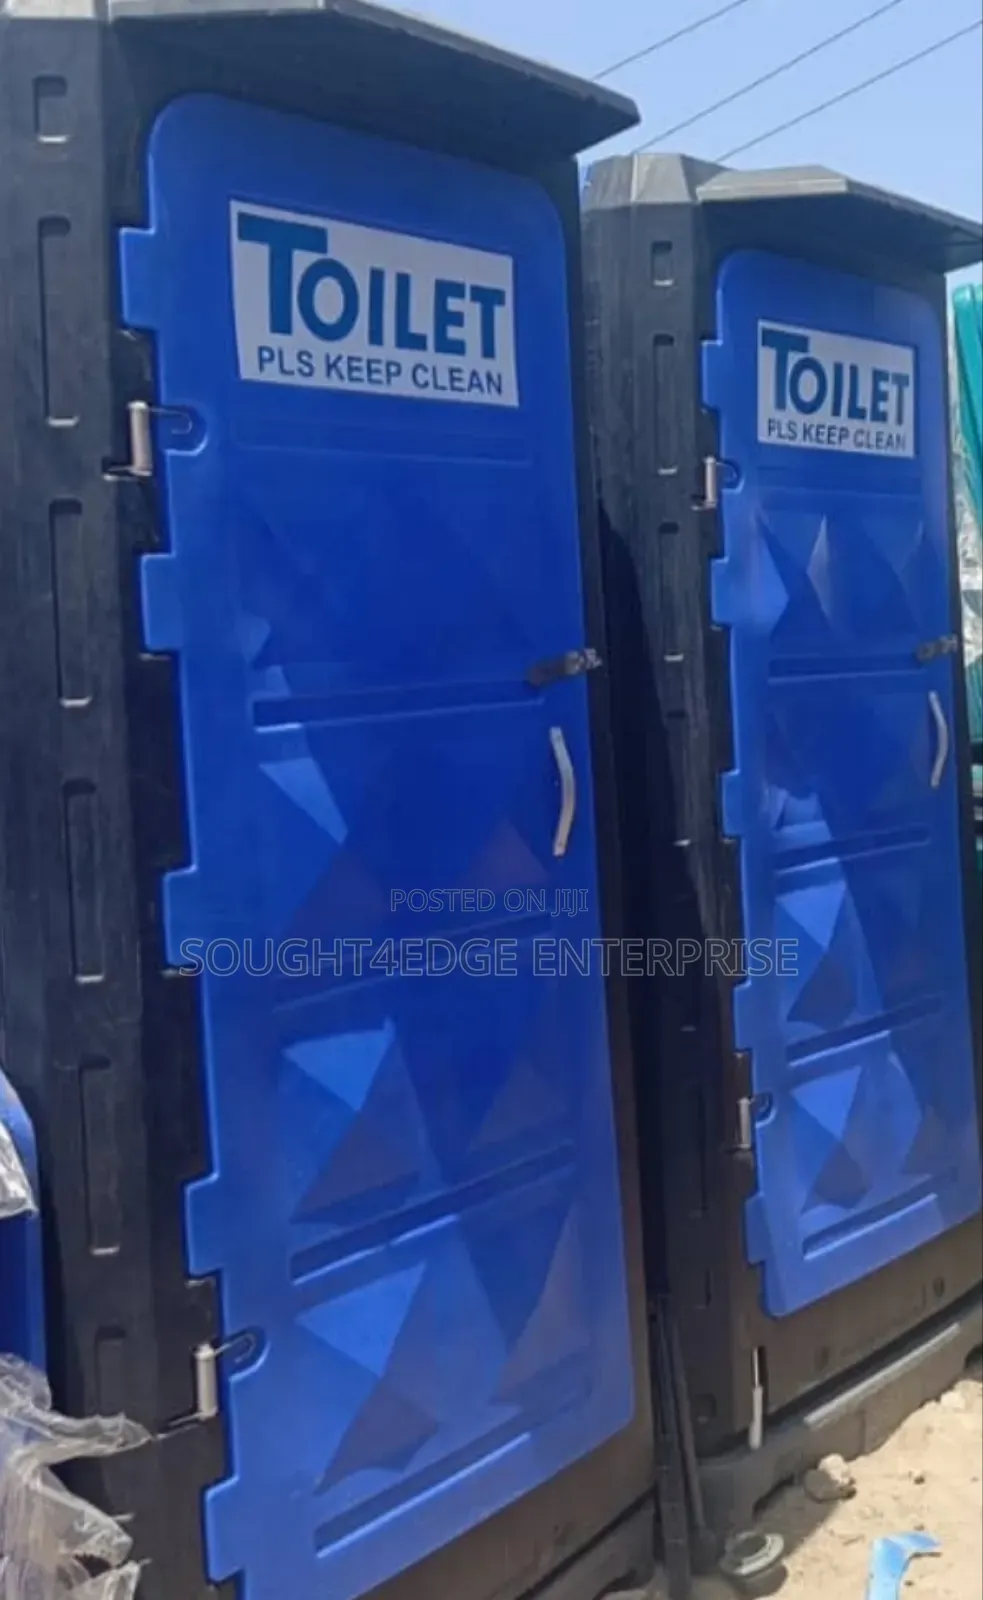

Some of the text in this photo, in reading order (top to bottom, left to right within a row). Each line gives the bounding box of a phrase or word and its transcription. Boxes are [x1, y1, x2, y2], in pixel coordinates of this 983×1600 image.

[237, 210, 505, 359] TOILET
[257, 346, 503, 396] PLS KEEP CLEAN
[761, 328, 909, 426] TOILET
[768, 418, 905, 452] PLS KEEP CLEAN
